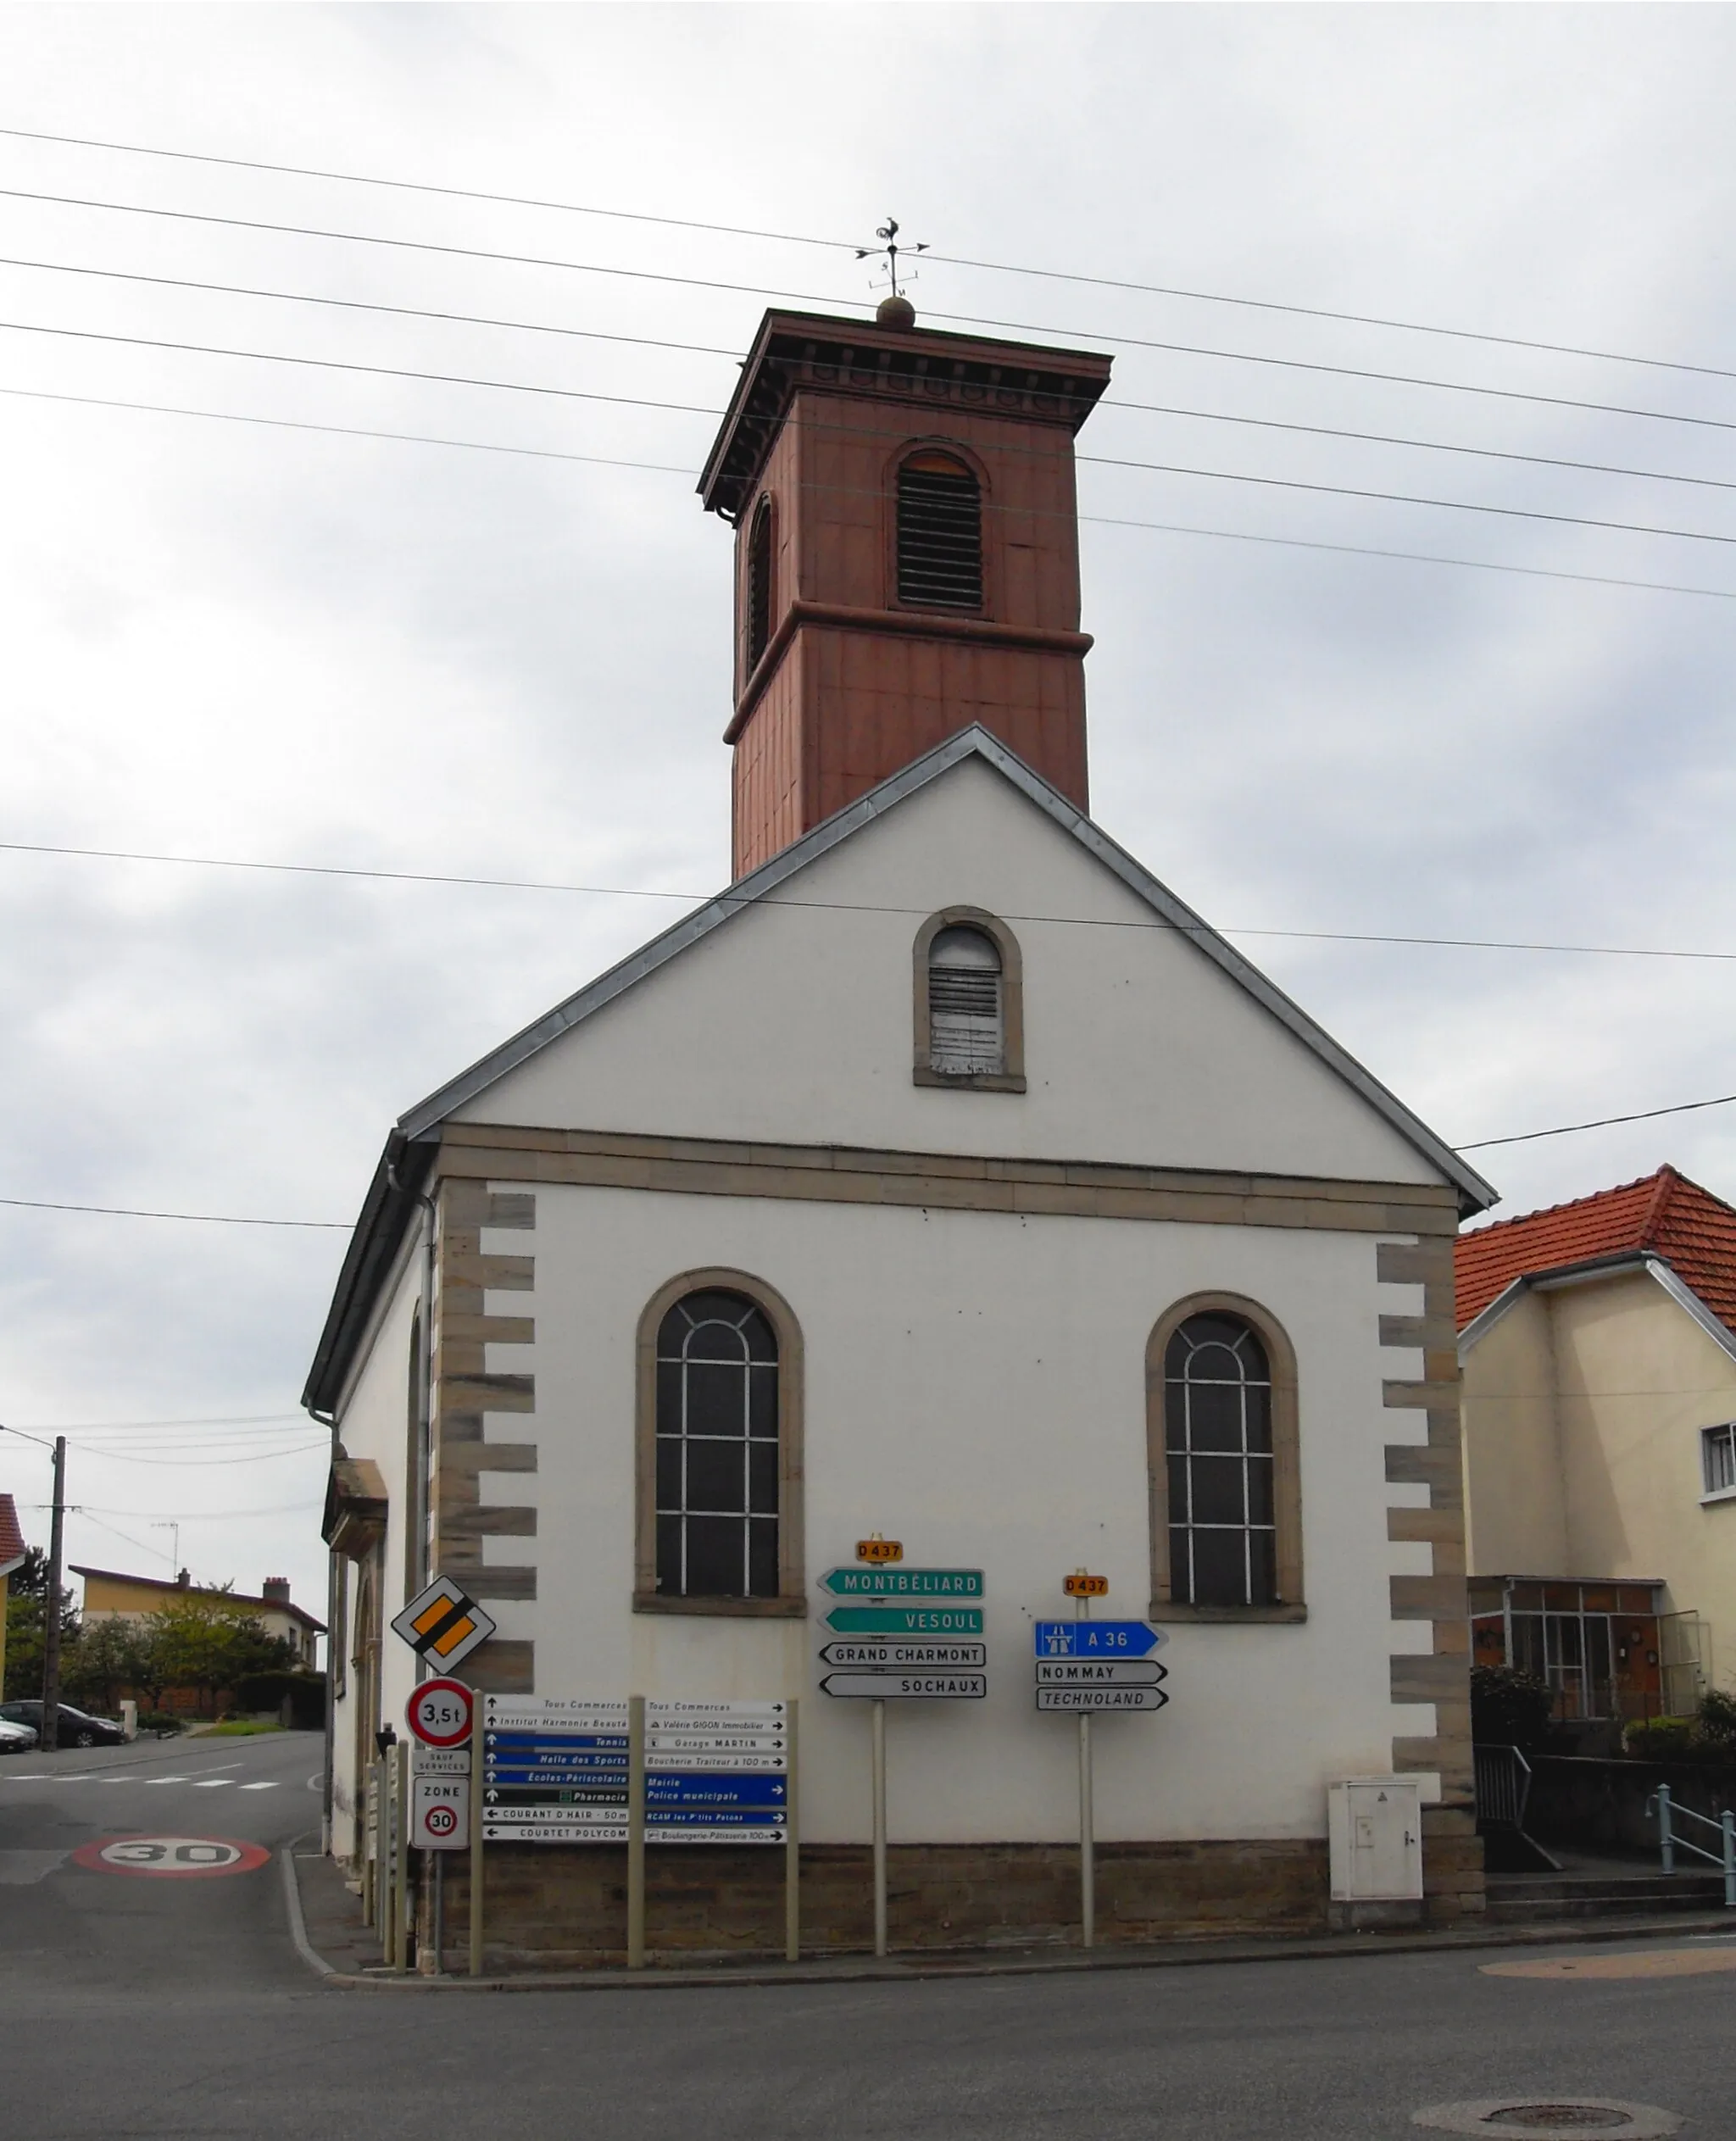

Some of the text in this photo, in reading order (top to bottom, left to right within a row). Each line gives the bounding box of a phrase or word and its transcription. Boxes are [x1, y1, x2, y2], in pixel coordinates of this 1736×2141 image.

[871, 1545, 900, 1557] 437
[844, 1574, 976, 1592] MONTBÉLIARD
[1078, 1580, 1105, 1592] 437
[906, 1614, 977, 1628] VESOUL
[1088, 1632, 1127, 1647] A 36
[836, 1649, 979, 1661] GRAND CHARMONT
[1043, 1667, 1115, 1679] NOMMAY
[902, 1681, 979, 1693] SOCHAUX
[544, 1699, 627, 1710] Tous Commerces
[1045, 1693, 1144, 1706] TECHNOLAND
[649, 1702, 731, 1712] Tous Commerces
[500, 1717, 627, 1728] Institut Harmonie Beauté
[663, 1720, 765, 1731] Valérie GIGON Immobilier
[596, 1738, 627, 1747] Tennis
[675, 1739, 710, 1749] Garage
[572, 1756, 589, 1765] des
[594, 1756, 627, 1766] Sports
[648, 1757, 693, 1766] Boucherie
[743, 1759, 760, 1767] 100
[648, 1778, 681, 1788] Mairie
[425, 1786, 459, 1798] ZONE
[574, 1793, 626, 1802] Pharmacie
[648, 1791, 738, 1802] Police municipale
[503, 1809, 552, 1818] COURANT
[432, 1815, 451, 1827] 30
[520, 1829, 570, 1838] COURTET
[112, 1843, 231, 1862] 30
